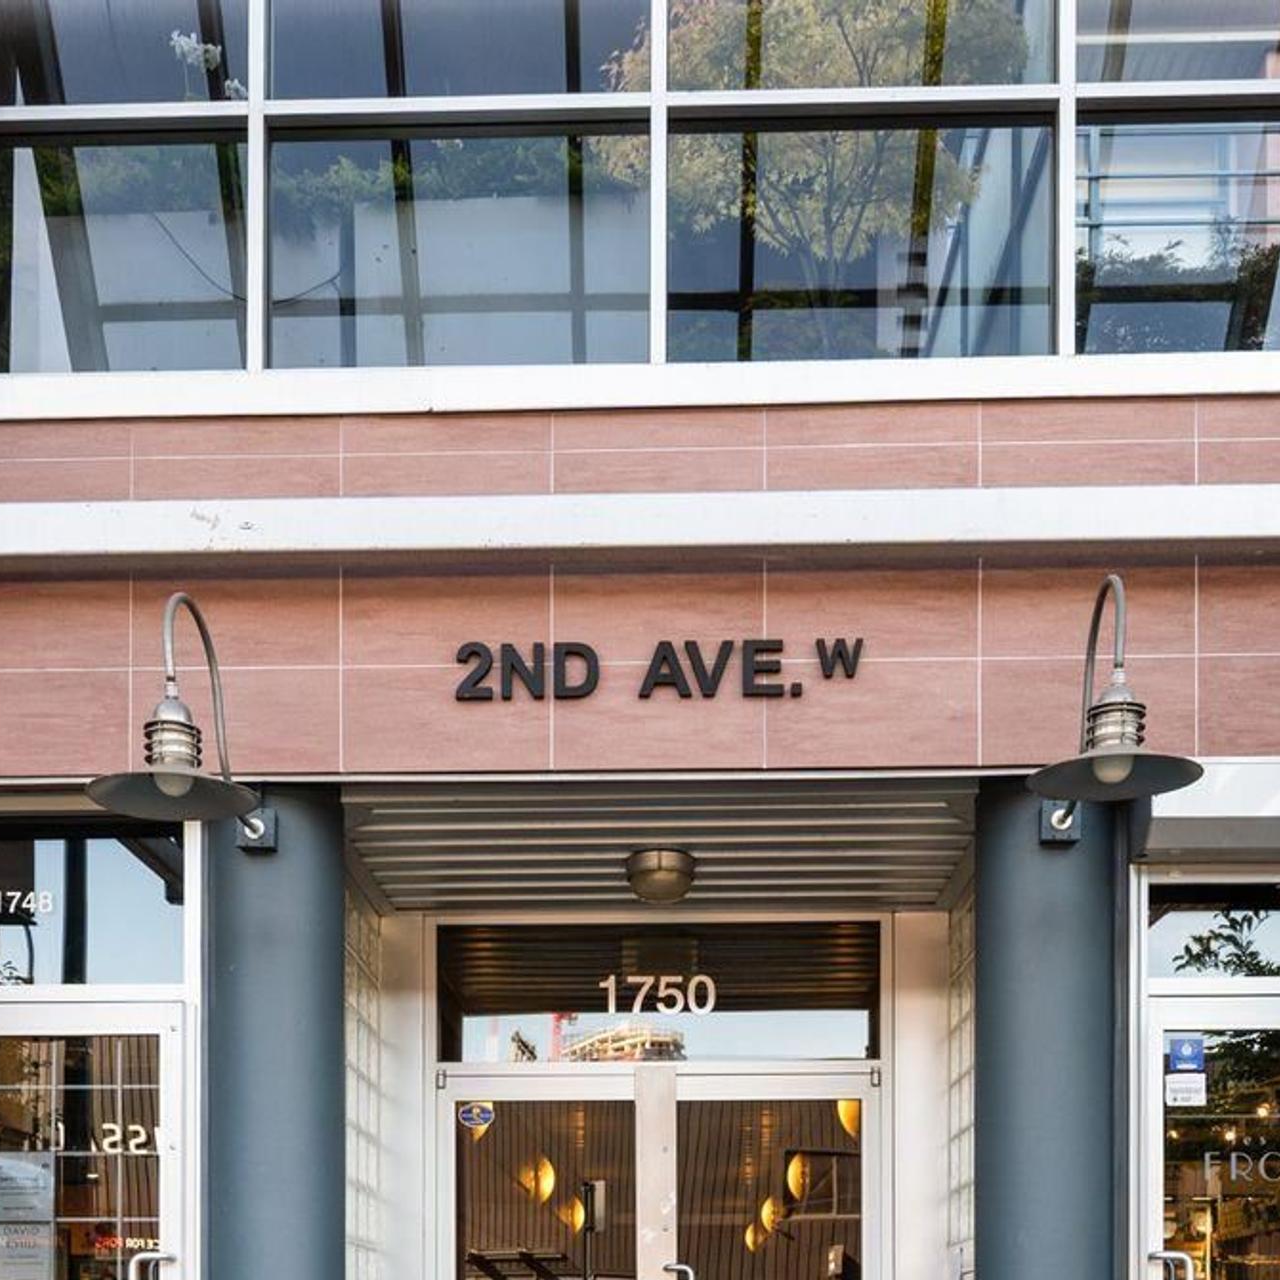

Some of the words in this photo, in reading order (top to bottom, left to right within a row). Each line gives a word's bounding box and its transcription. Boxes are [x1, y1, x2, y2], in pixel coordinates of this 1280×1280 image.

[456, 641, 600, 701] 2ND
[639, 639, 803, 699] AVE.
[816, 637, 863, 678] W
[598, 974, 716, 1016] 1750
